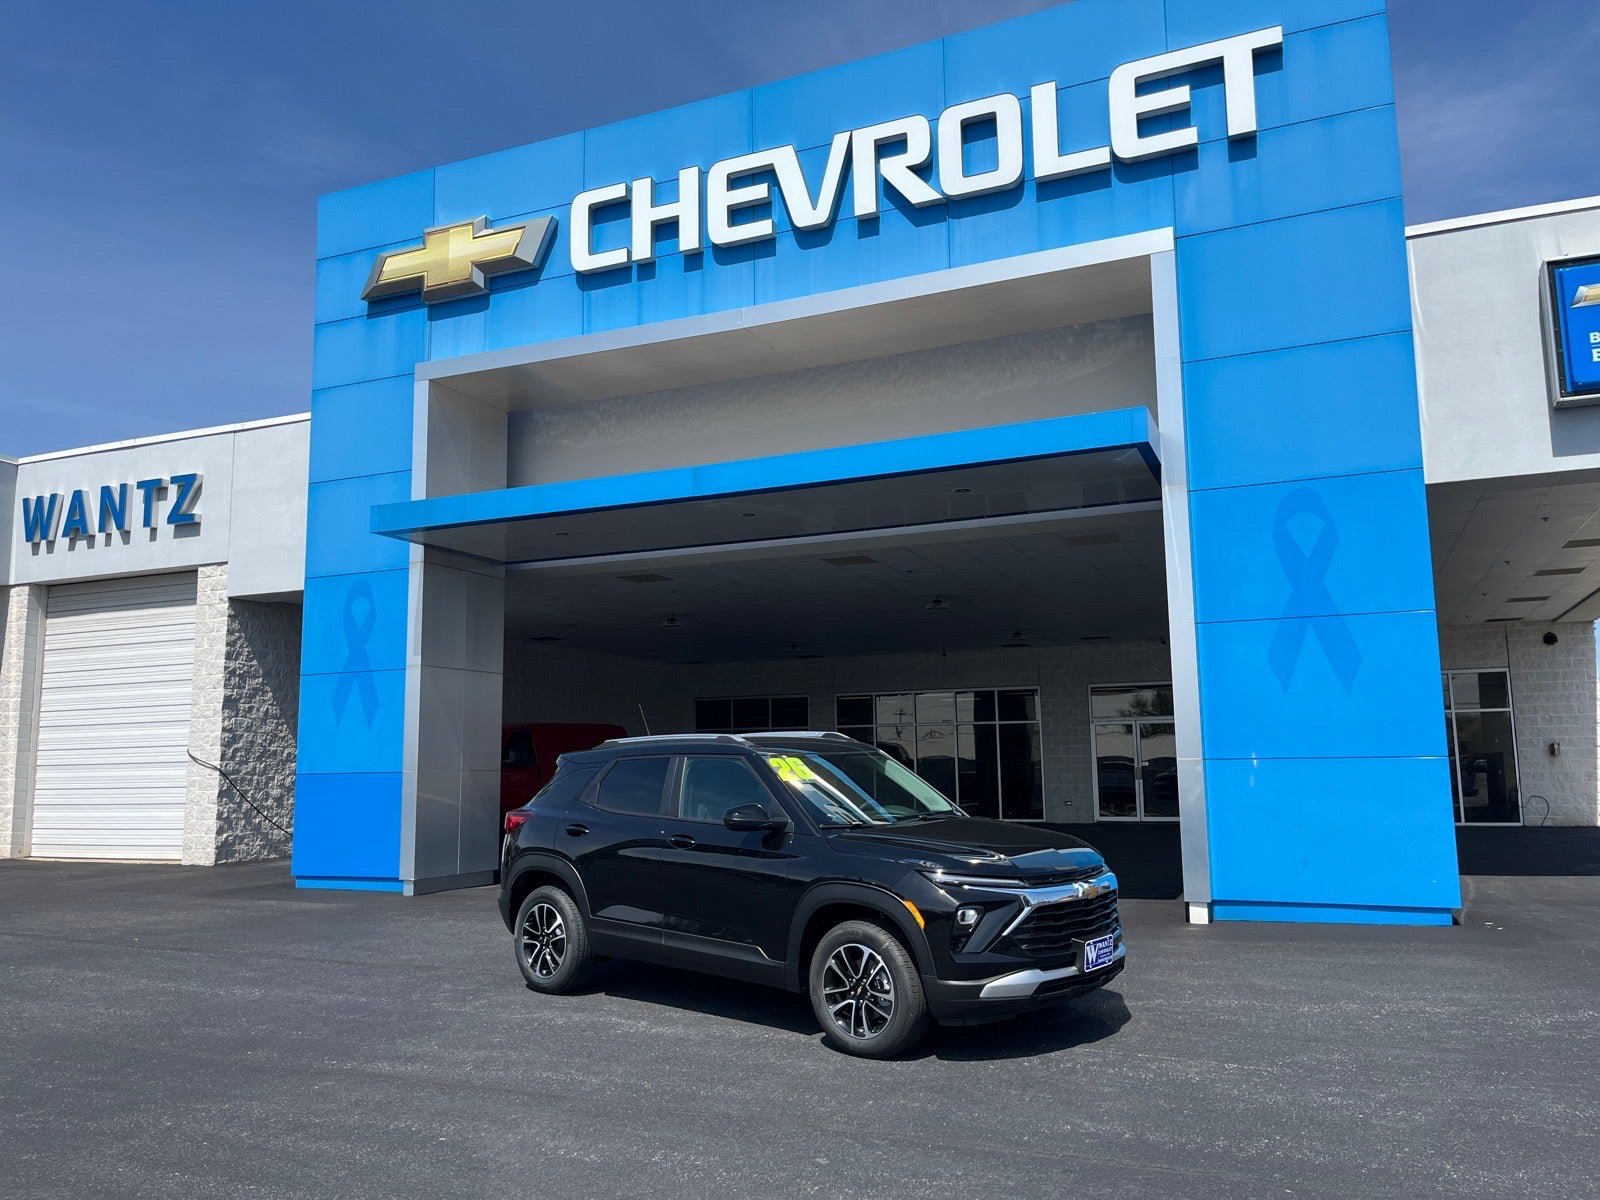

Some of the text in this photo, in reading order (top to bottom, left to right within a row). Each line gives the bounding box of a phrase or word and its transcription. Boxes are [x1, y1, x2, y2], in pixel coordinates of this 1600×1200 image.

[569, 26, 1283, 273] CHEVROLET
[22, 472, 203, 543] WANTZ
[768, 756, 816, 782] 26
